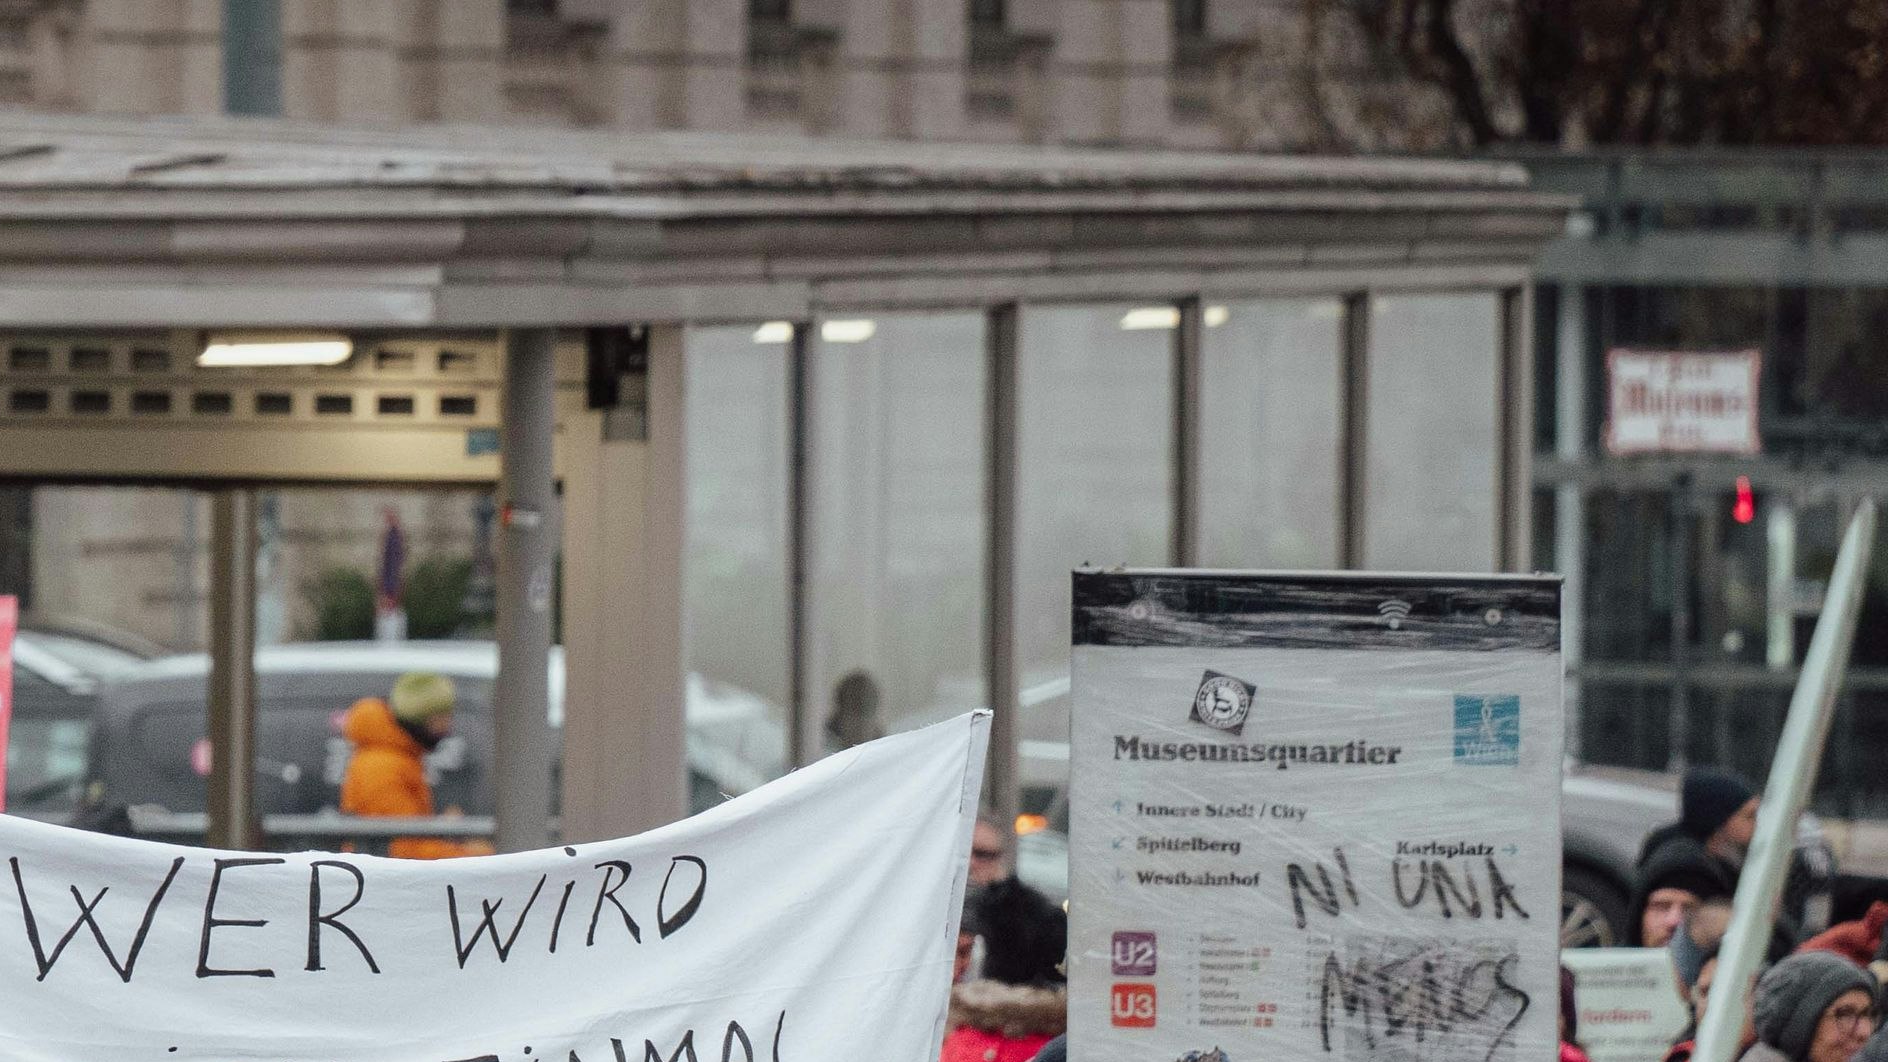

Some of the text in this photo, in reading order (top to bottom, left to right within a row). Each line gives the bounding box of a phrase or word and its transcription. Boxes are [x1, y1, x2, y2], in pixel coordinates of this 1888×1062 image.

[1113, 735, 1402, 770] Museumsquartier
[1270, 803, 1309, 822] City
[1396, 840, 1495, 861] Karlsplatz
[1137, 870, 1260, 887] Westbahnhof
[8, 855, 381, 983] WER
[1114, 940, 1155, 968] U2
[1114, 991, 1153, 1020] U3
